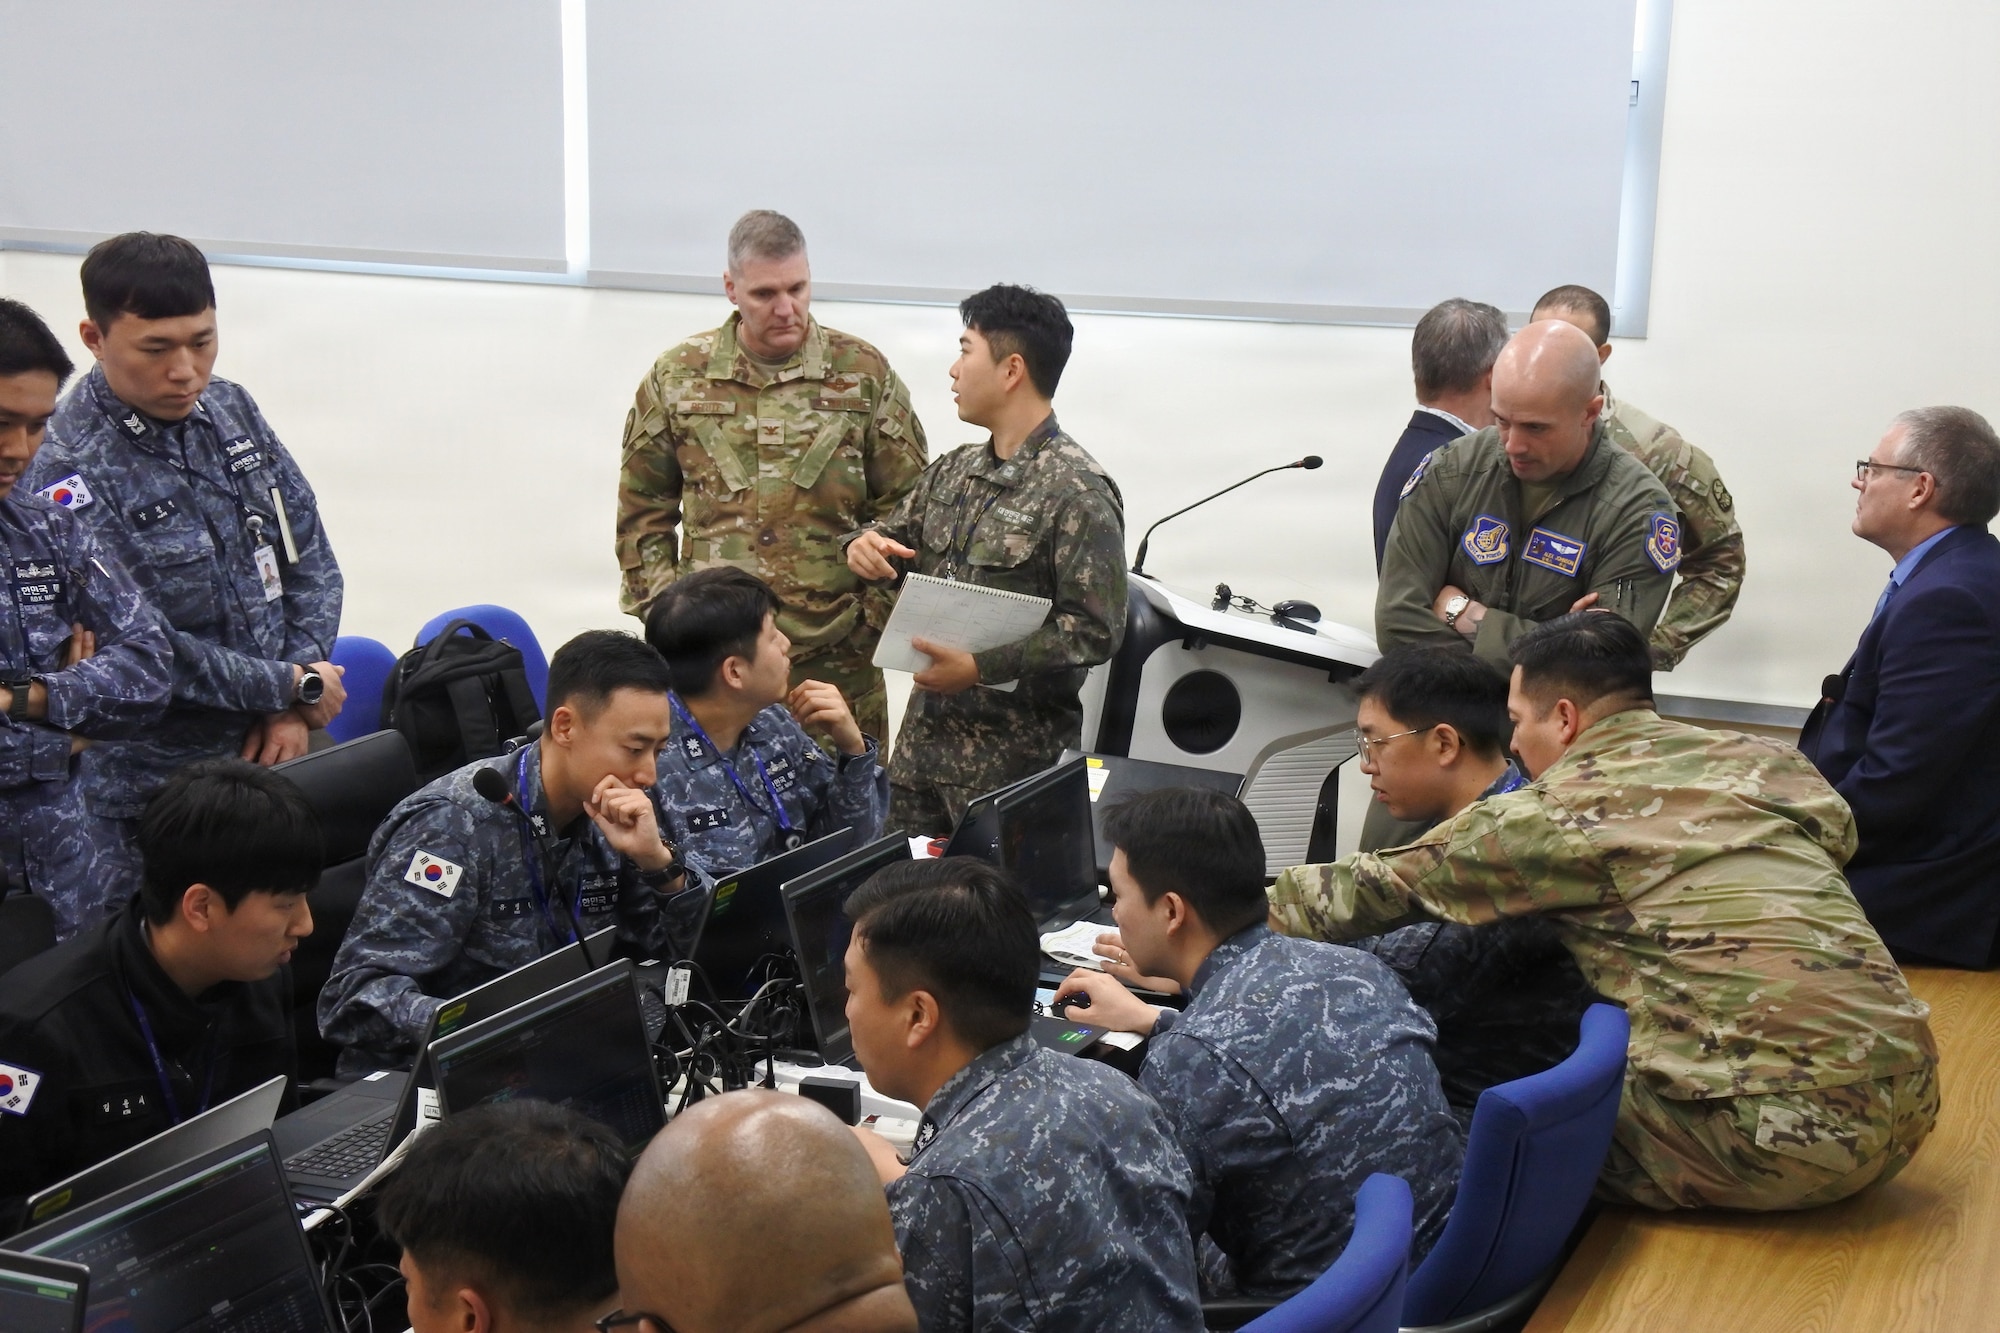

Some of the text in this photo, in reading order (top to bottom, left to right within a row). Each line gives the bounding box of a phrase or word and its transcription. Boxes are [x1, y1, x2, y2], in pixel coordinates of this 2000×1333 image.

[1555, 555, 1575, 566] JOHNSON
[21, 584, 48, 596] 한민국
[581, 895, 606, 907] 한민국
